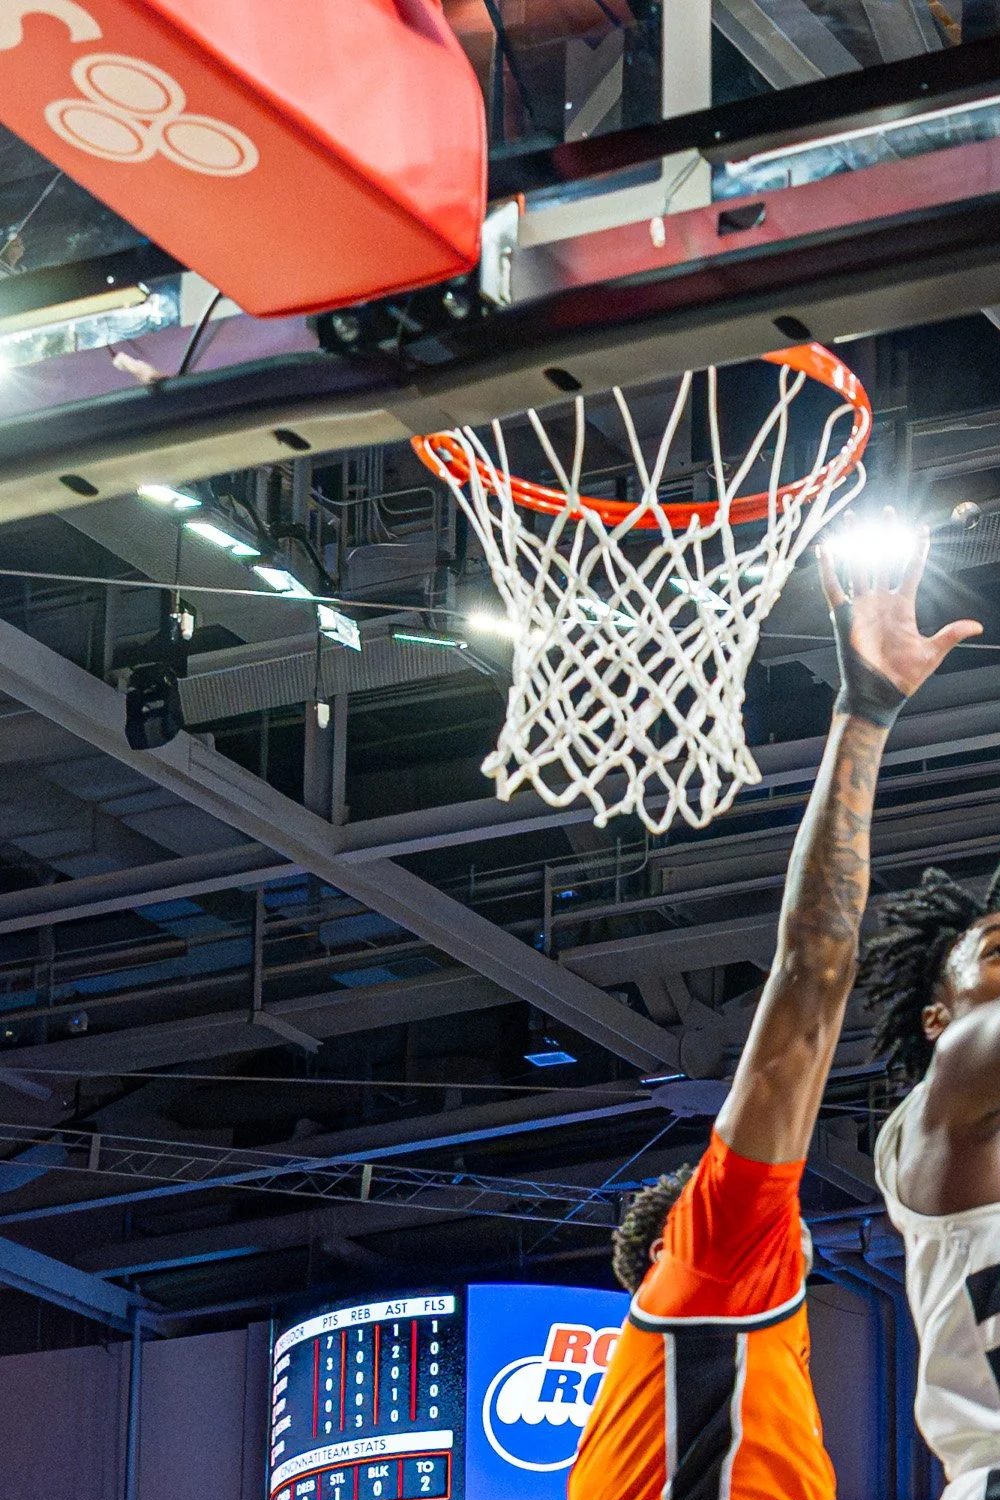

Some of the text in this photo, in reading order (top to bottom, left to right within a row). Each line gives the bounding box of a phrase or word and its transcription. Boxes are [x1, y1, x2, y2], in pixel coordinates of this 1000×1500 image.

[322, 1314, 339, 1329] PTS
[350, 1308, 371, 1322] REB
[385, 1302, 408, 1316] AST
[424, 1299, 446, 1312] FLS
[326, 1320, 438, 1349] 7 1 1 1
[326, 1341, 439, 1371] 3 0 2 0
[325, 1362, 439, 1392] 0 0 0 0
[325, 1384, 439, 1413] 0 0 1 0
[324, 1405, 439, 1434] 9 3 0 0
[322, 1445, 350, 1461] TEAM
[353, 1439, 386, 1455] STATS
[296, 1480, 316, 1496] DREB
[329, 1472, 346, 1486] STL
[368, 1465, 390, 1479] BLK
[416, 1461, 434, 1474] TO
[372, 1480, 382, 1497] 0
[420, 1475, 431, 1492] 2
